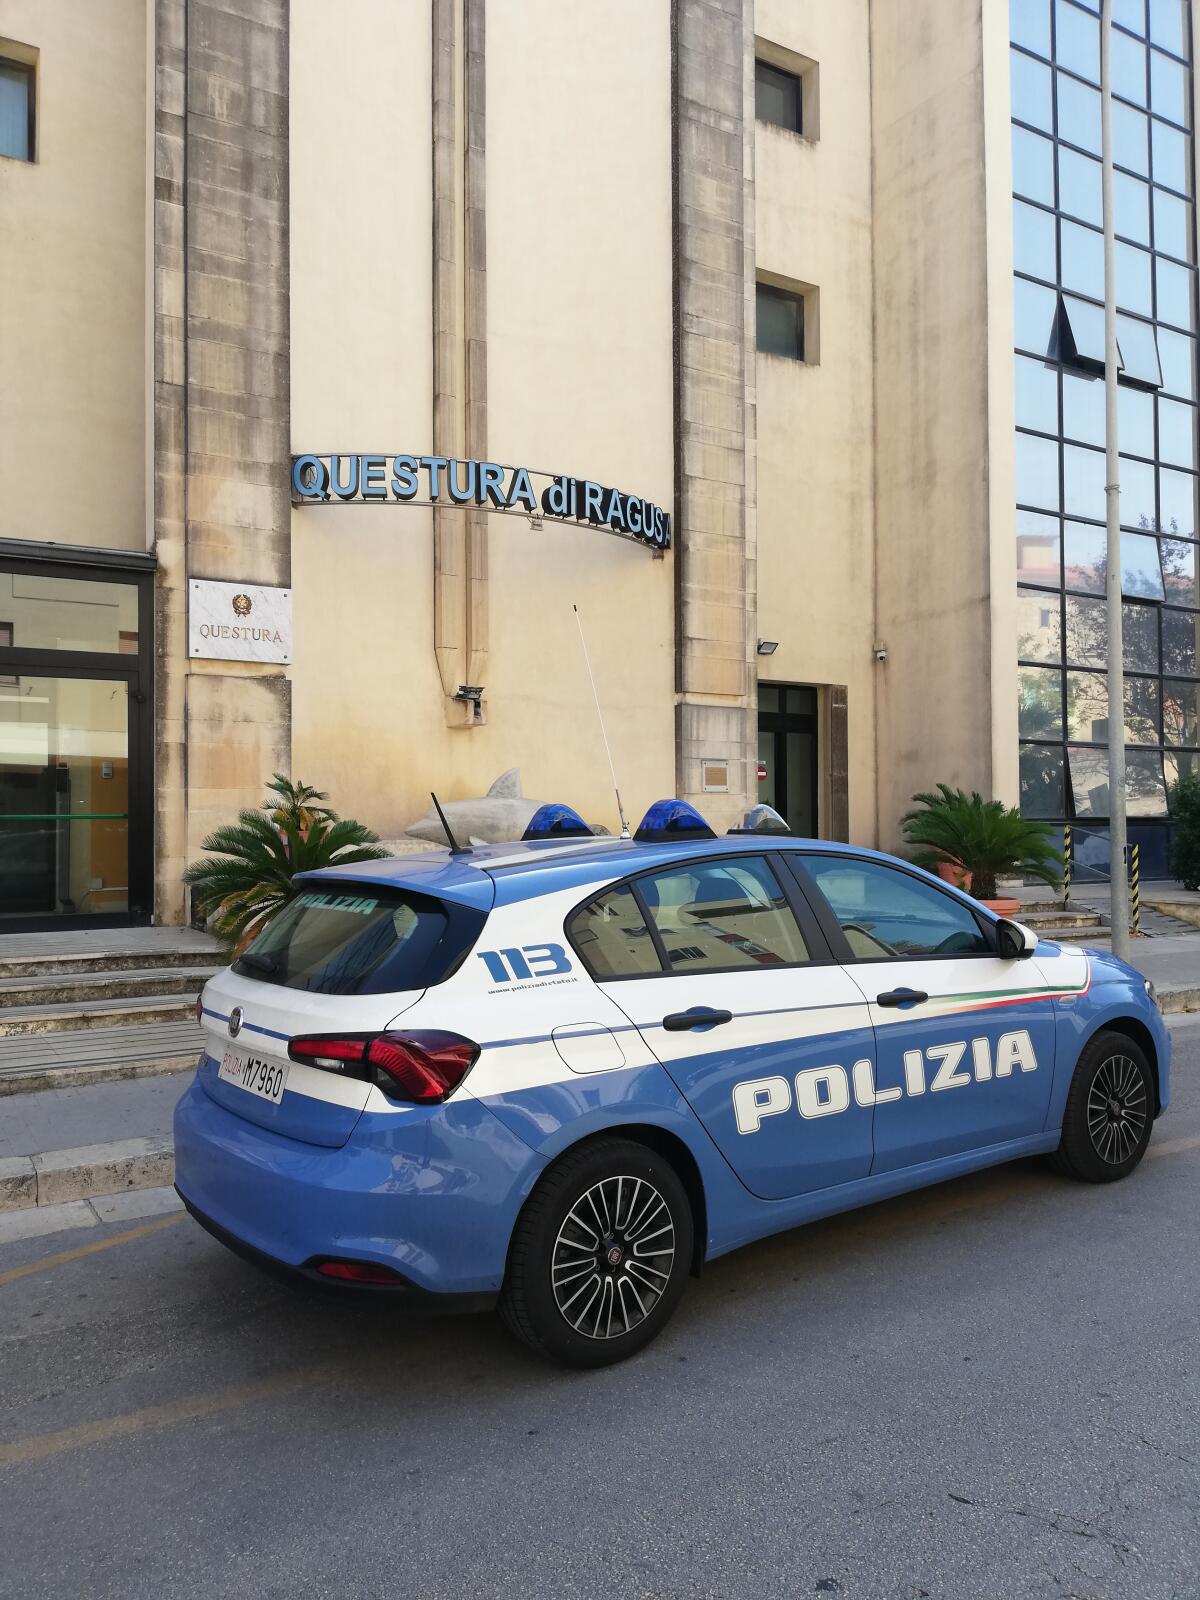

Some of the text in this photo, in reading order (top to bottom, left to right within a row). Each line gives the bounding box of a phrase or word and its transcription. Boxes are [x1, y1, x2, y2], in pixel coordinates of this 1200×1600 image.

[292, 455, 671, 548] QUESTURA di RAGUSA
[199, 623, 283, 643] QUESTURA
[476, 942, 572, 984] 113
[242, 1056, 284, 1099] M7960
[732, 1029, 1038, 1135] POLIZIA
